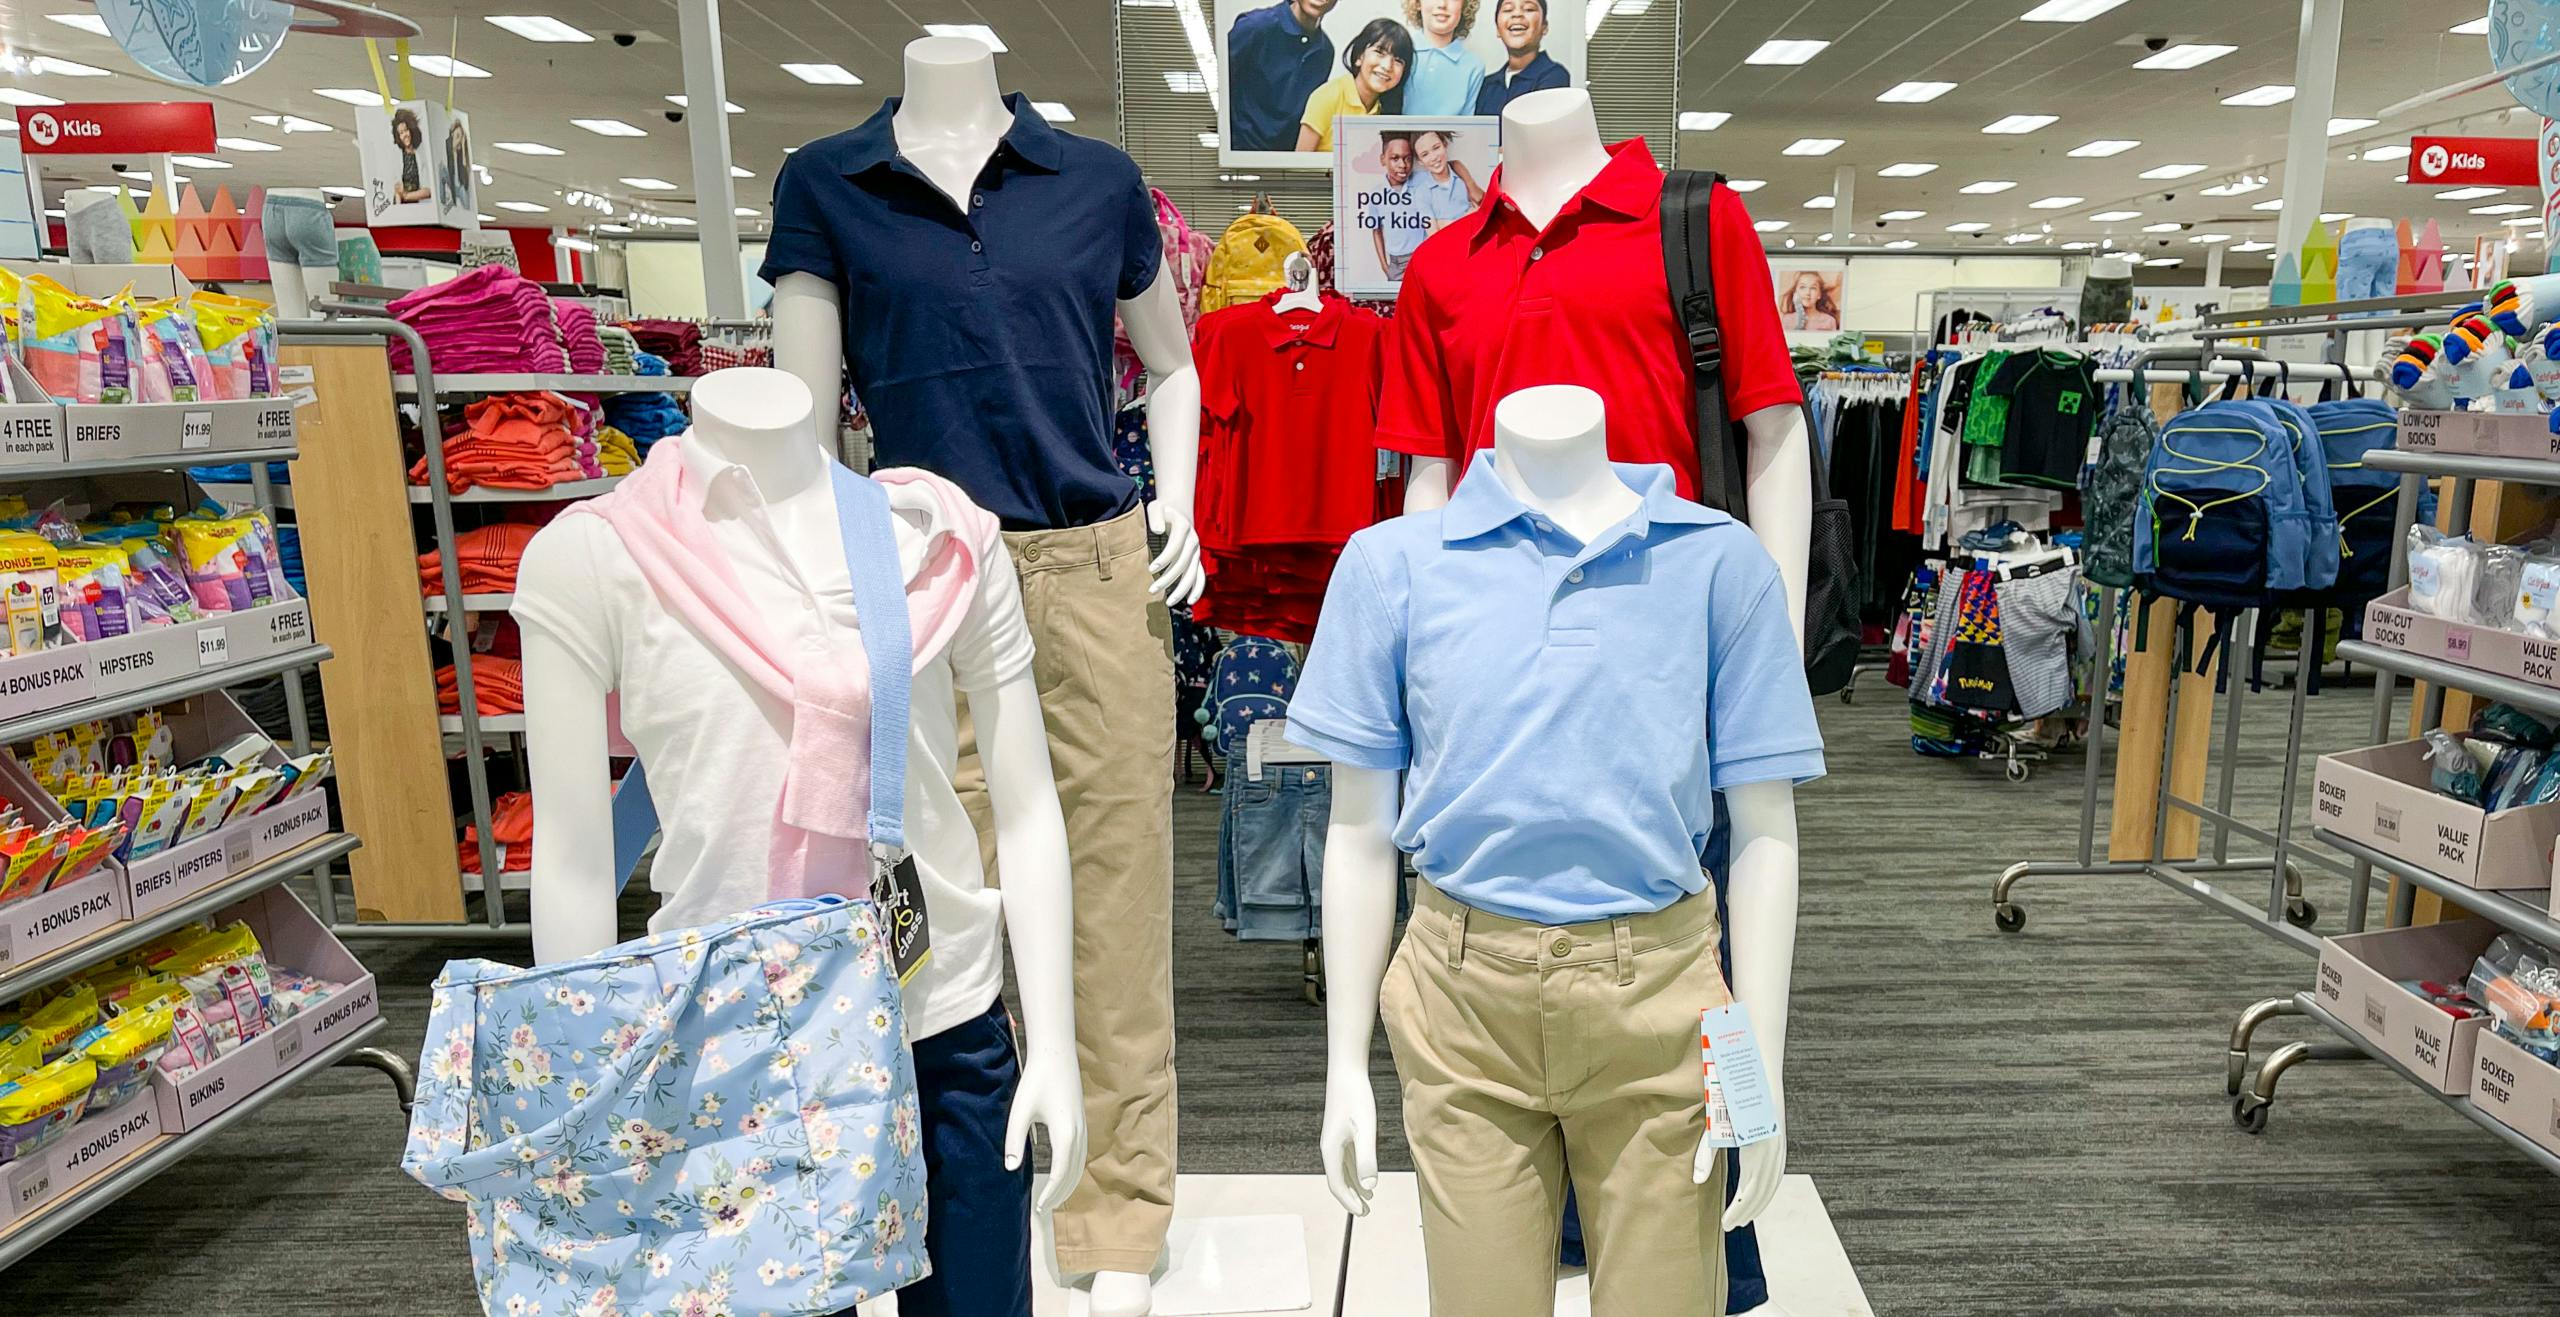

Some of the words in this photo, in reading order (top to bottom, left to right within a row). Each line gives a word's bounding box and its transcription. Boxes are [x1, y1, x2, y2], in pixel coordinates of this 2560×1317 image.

[63, 121, 101, 136] Kids
[2451, 153, 2485, 169] Kids
[1358, 188, 1412, 209] polos
[1358, 212, 1385, 229] for
[1391, 211, 1431, 229] kids
[4, 420, 12, 438] 4
[16, 419, 52, 438] FREE
[258, 412, 263, 426] 4
[266, 410, 291, 426] FREE
[2403, 413, 2440, 427] LOW-CUT
[76, 425, 121, 441] BRIEFS
[185, 423, 210, 436] $11.99
[258, 430, 263, 439] in
[264, 430, 277, 439] each
[278, 429, 291, 440] pack
[2407, 432, 2436, 446] SOCKS
[6, 442, 13, 453] in
[15, 441, 34, 453] each
[36, 441, 54, 454] pack
[270, 618, 277, 632] 4
[279, 611, 304, 631] FREE
[2372, 608, 2413, 629] LOW-CUT
[200, 638, 225, 653] $11.99
[279, 632, 292, 642] each
[293, 629, 306, 641] pack
[2375, 627, 2405, 646] SOCKS
[2523, 640, 2558, 660] VALUE
[100, 651, 154, 676] HIPSTERS
[2523, 661, 2552, 680] PACK
[10, 671, 51, 695] BONUS
[53, 663, 84, 685] PACK
[2319, 780, 2346, 801] BOXER
[2319, 798, 2343, 818] BRIEF
[263, 827, 272, 843] +1
[273, 817, 301, 838] BONUS
[302, 806, 322, 825] PACK
[2437, 823, 2469, 847] VALUE
[2438, 843, 2465, 864] PACK
[135, 871, 171, 897] BRIEFS
[178, 849, 223, 879] HIPSTERS
[27, 921, 39, 939] +1
[42, 905, 81, 933] BONUS
[82, 892, 112, 922] PACK
[899, 911, 924, 959] class
[2321, 962, 2343, 987] BOXER
[2321, 980, 2340, 1001] BRIEF
[312, 1019, 323, 1036] +4
[323, 1004, 351, 1028] BONUS
[351, 991, 373, 1016] PACK
[2414, 1025, 2441, 1051] VALUE
[2415, 1044, 2437, 1069] PACK
[2481, 1056, 2515, 1088] BOXER
[189, 1077, 225, 1107] BIKINIS
[2481, 1078, 2510, 1104] BRIEF
[66, 1152, 79, 1171] +4
[80, 1132, 120, 1162] BONUS
[121, 1110, 151, 1139] PACK
